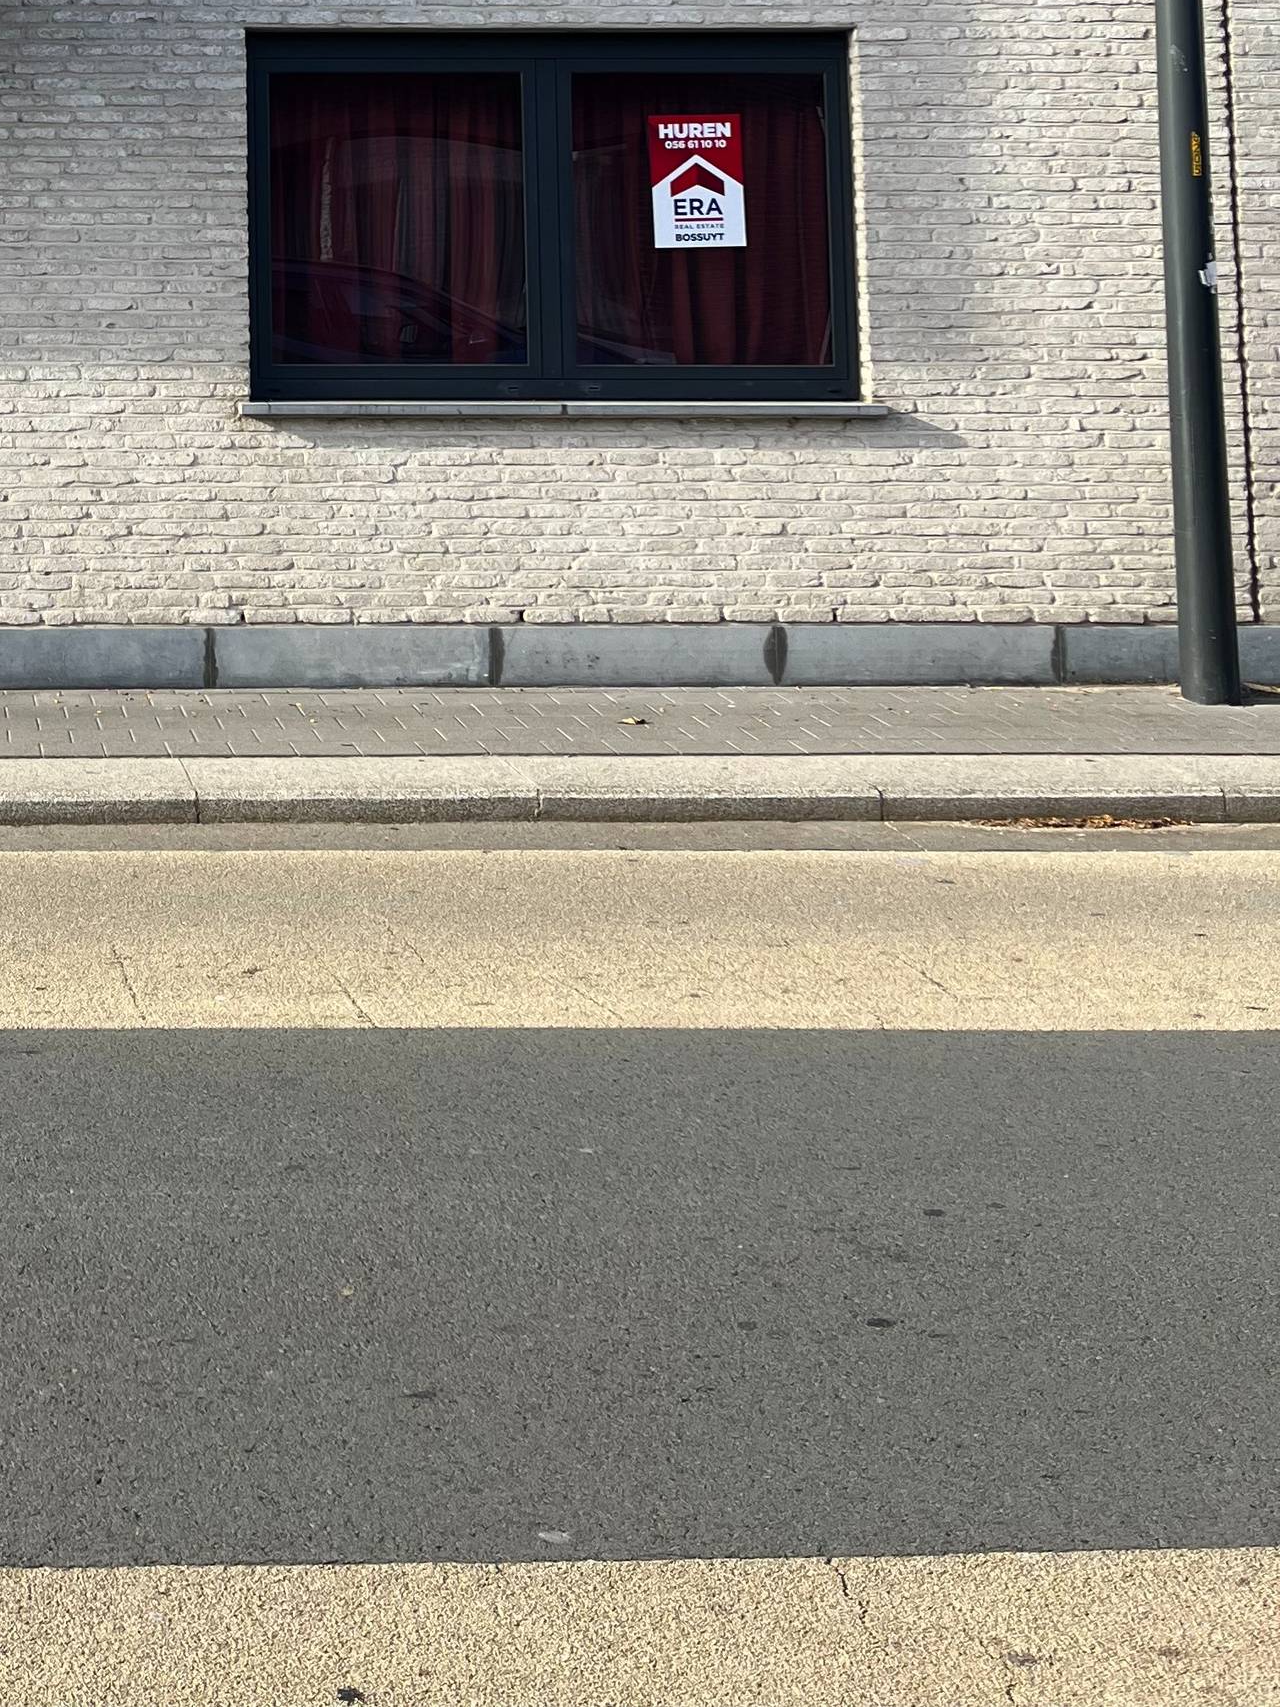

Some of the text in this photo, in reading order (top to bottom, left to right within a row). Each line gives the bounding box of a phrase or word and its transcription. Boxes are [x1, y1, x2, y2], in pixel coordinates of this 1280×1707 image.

[658, 122, 732, 139] HUREN
[665, 139, 727, 149] 056 61 10 10
[673, 197, 723, 216] ERA
[675, 232, 725, 242] BOSSUYT
